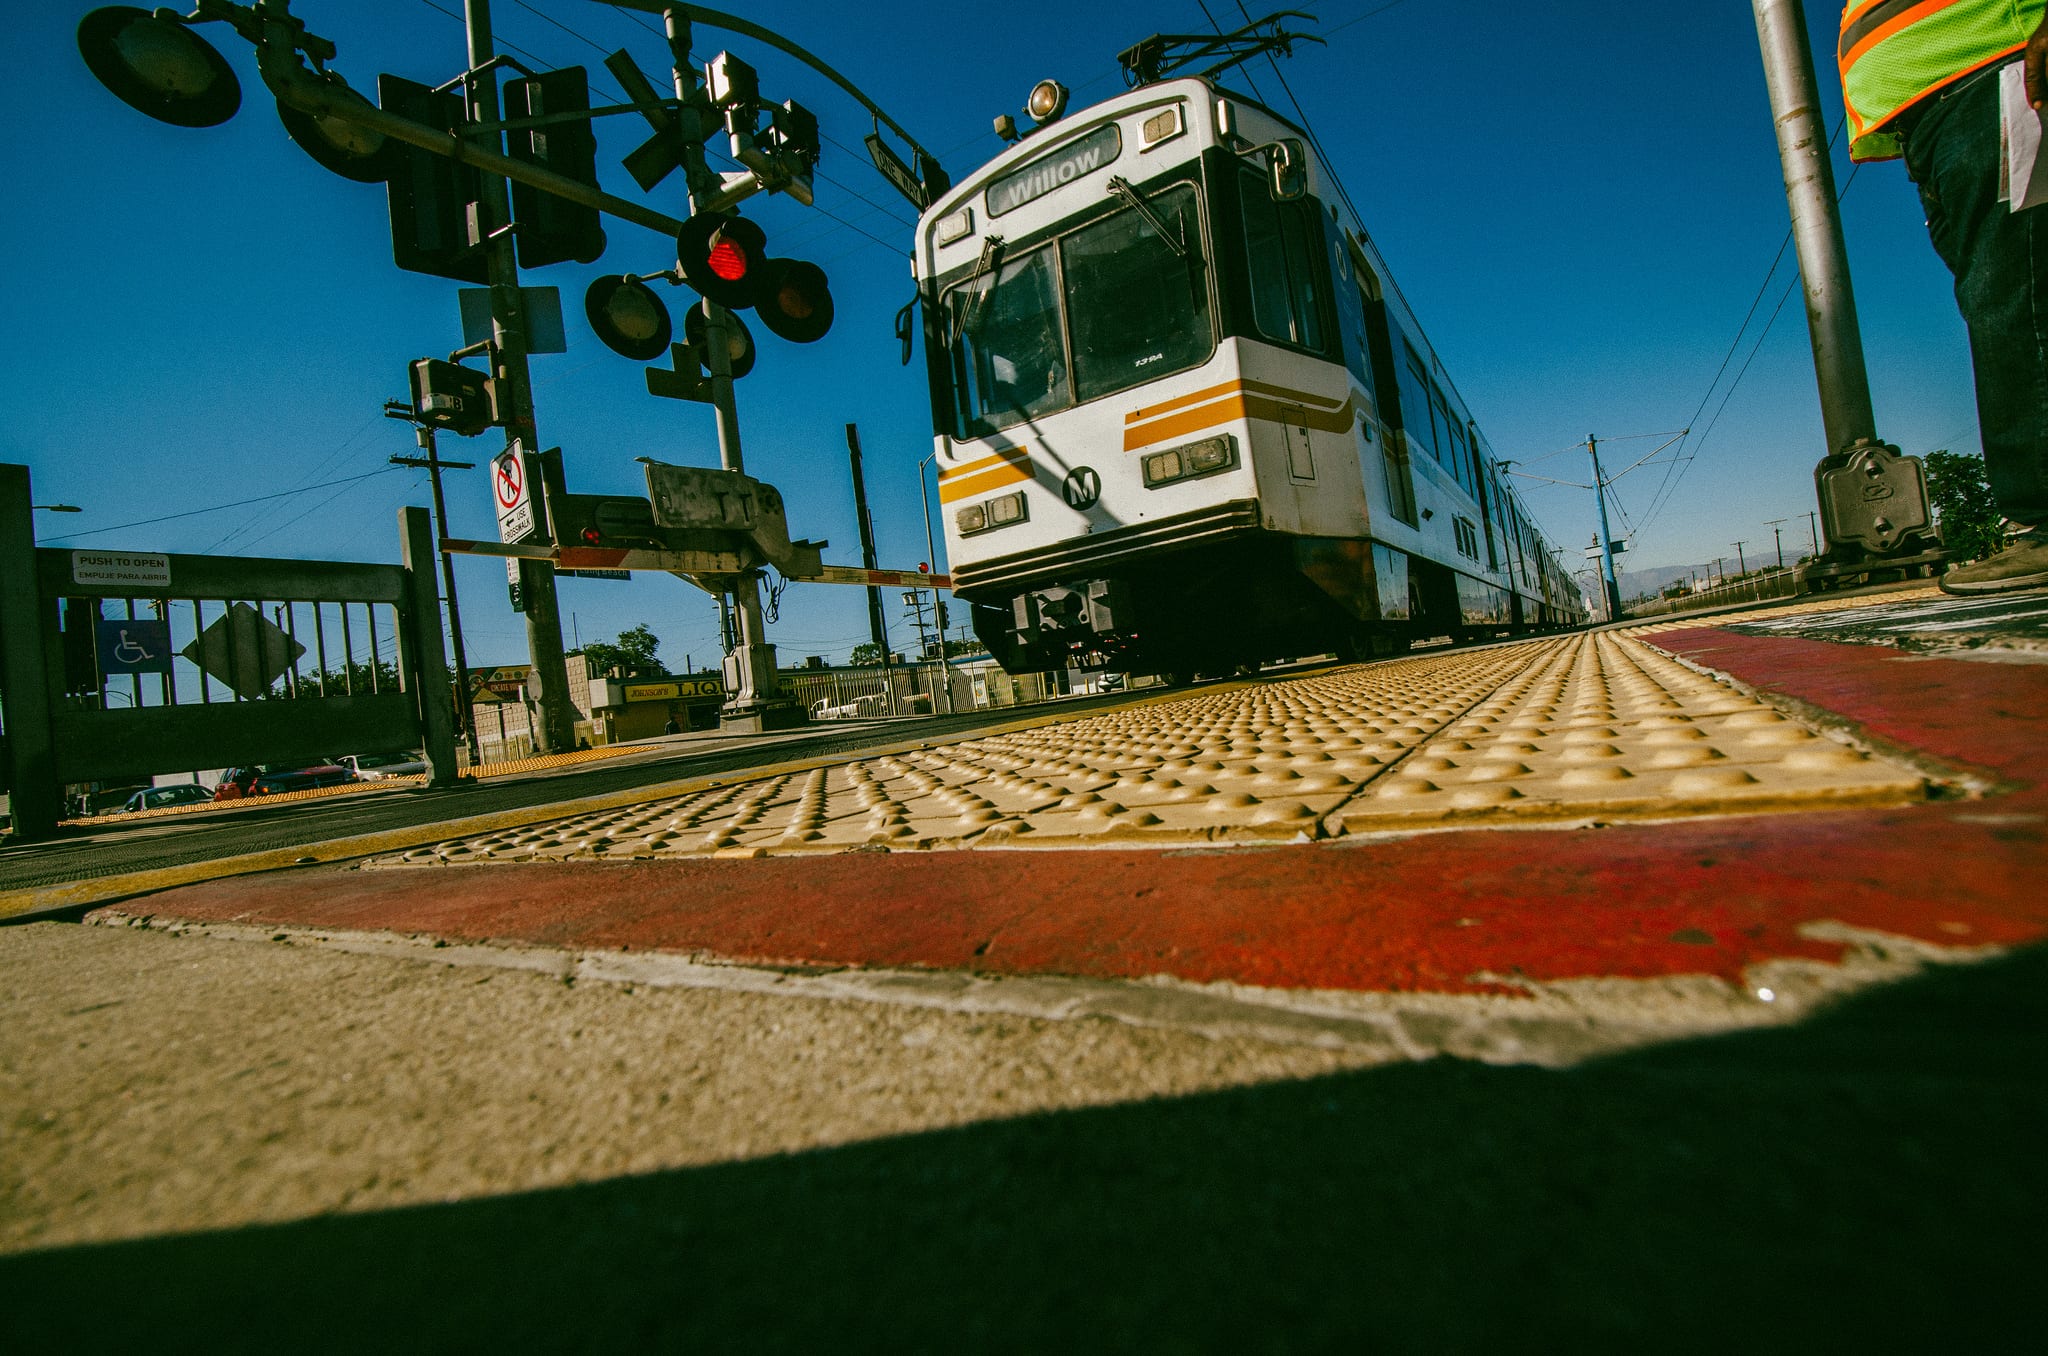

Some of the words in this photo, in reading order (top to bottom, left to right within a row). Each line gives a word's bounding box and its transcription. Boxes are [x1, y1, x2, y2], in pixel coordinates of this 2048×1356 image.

[878, 149, 897, 181] ONE
[902, 173, 920, 201] WAY
[1008, 147, 1100, 206] Willow
[516, 507, 526, 521] USE
[504, 517, 531, 542] CROSSWALK
[80, 556, 112, 566] PUSH
[116, 557, 131, 567] TO
[133, 558, 165, 568] OPEN
[79, 571, 115, 580] EMPUJE
[116, 572, 141, 580] PARA
[631, 688, 669, 698] JOHNSON'S
